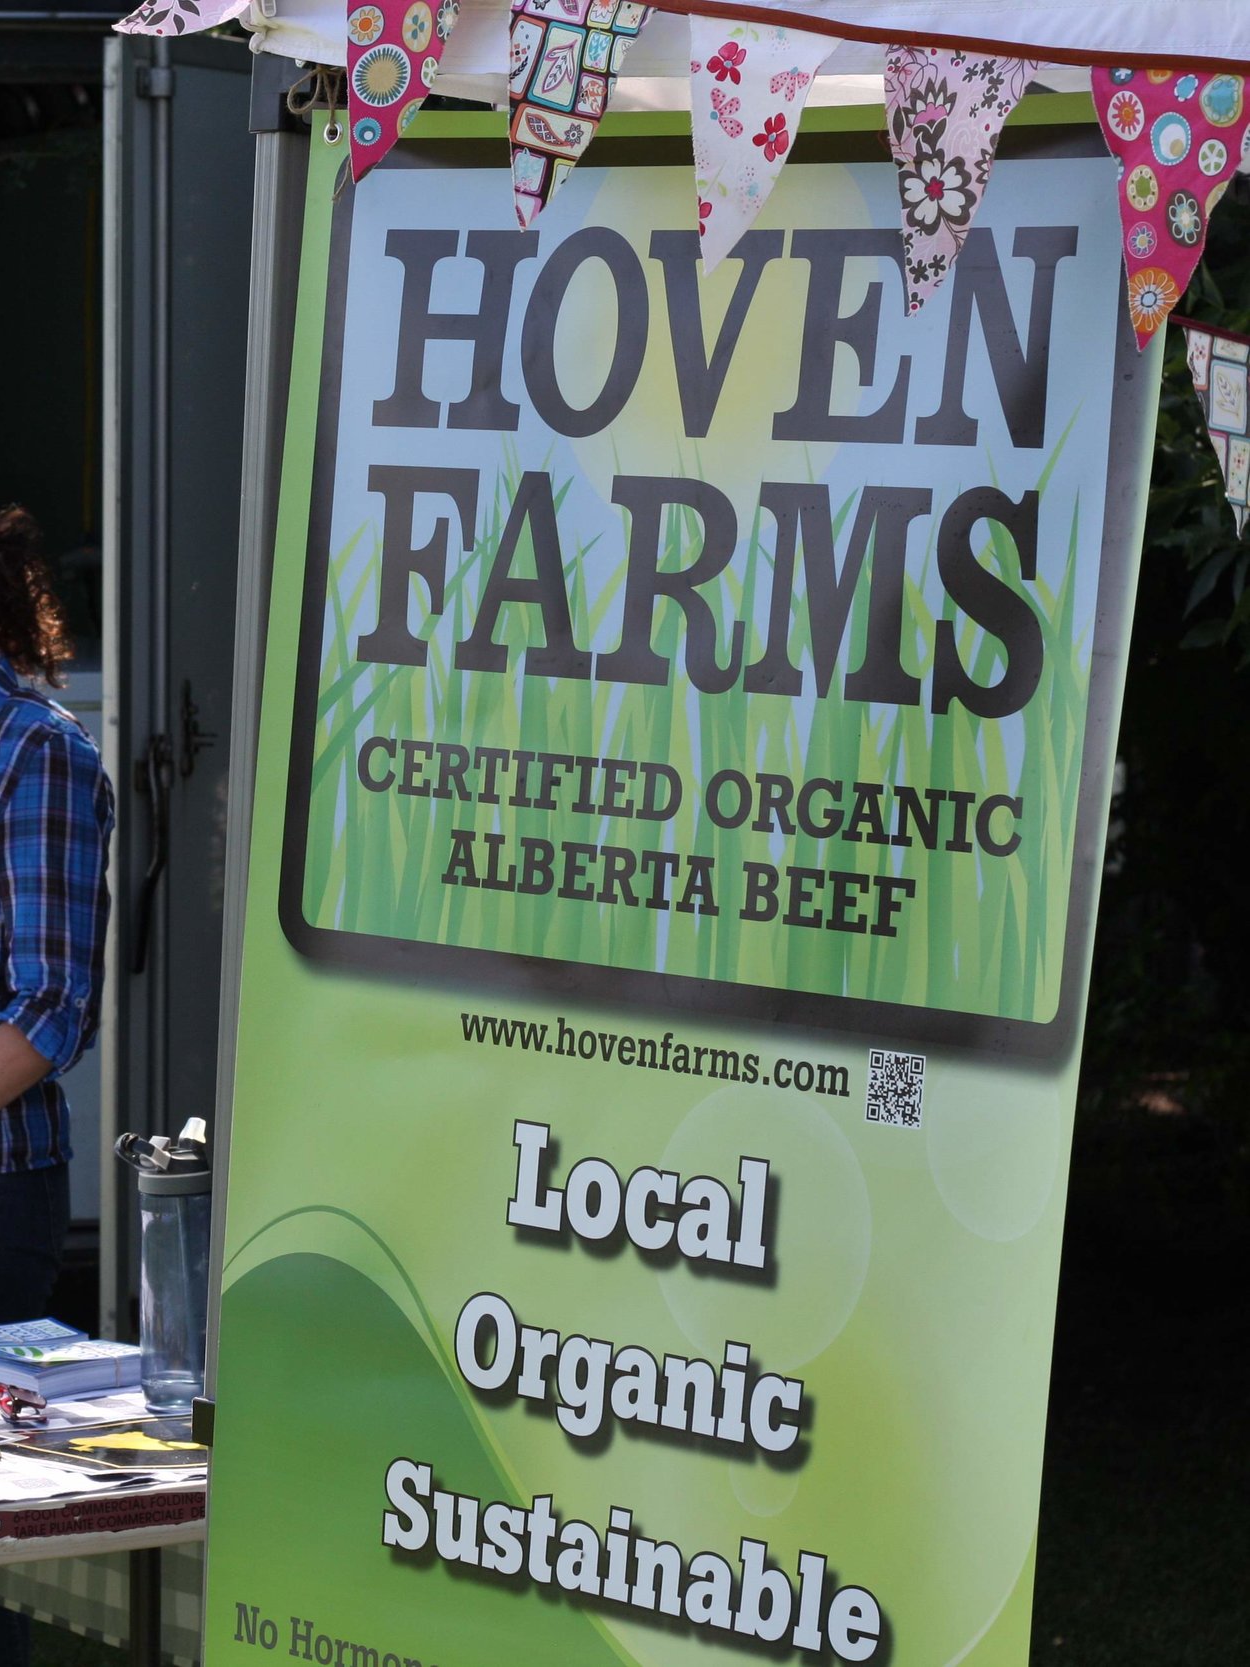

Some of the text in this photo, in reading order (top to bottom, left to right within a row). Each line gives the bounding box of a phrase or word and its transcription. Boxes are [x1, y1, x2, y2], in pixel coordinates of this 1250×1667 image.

[372, 226, 1079, 449] HOVEN
[356, 464, 1044, 719] FARMS
[357, 736, 1023, 857] CERTIFIED ORGANIC
[442, 829, 916, 938] ALBERTA BEEF
[460, 1013, 850, 1097] www.hovenfarms.com
[506, 1119, 771, 1270] Local
[454, 1291, 804, 1453] Organic
[14, 1492, 203, 1523] 6-FOOT COMMERCIAL FOLDING
[14, 1524, 47, 1539] TABLE
[97, 1508, 184, 1528] COMMERCIALE
[381, 1457, 882, 1663] Sustainable
[234, 1602, 439, 1667] No Horm
